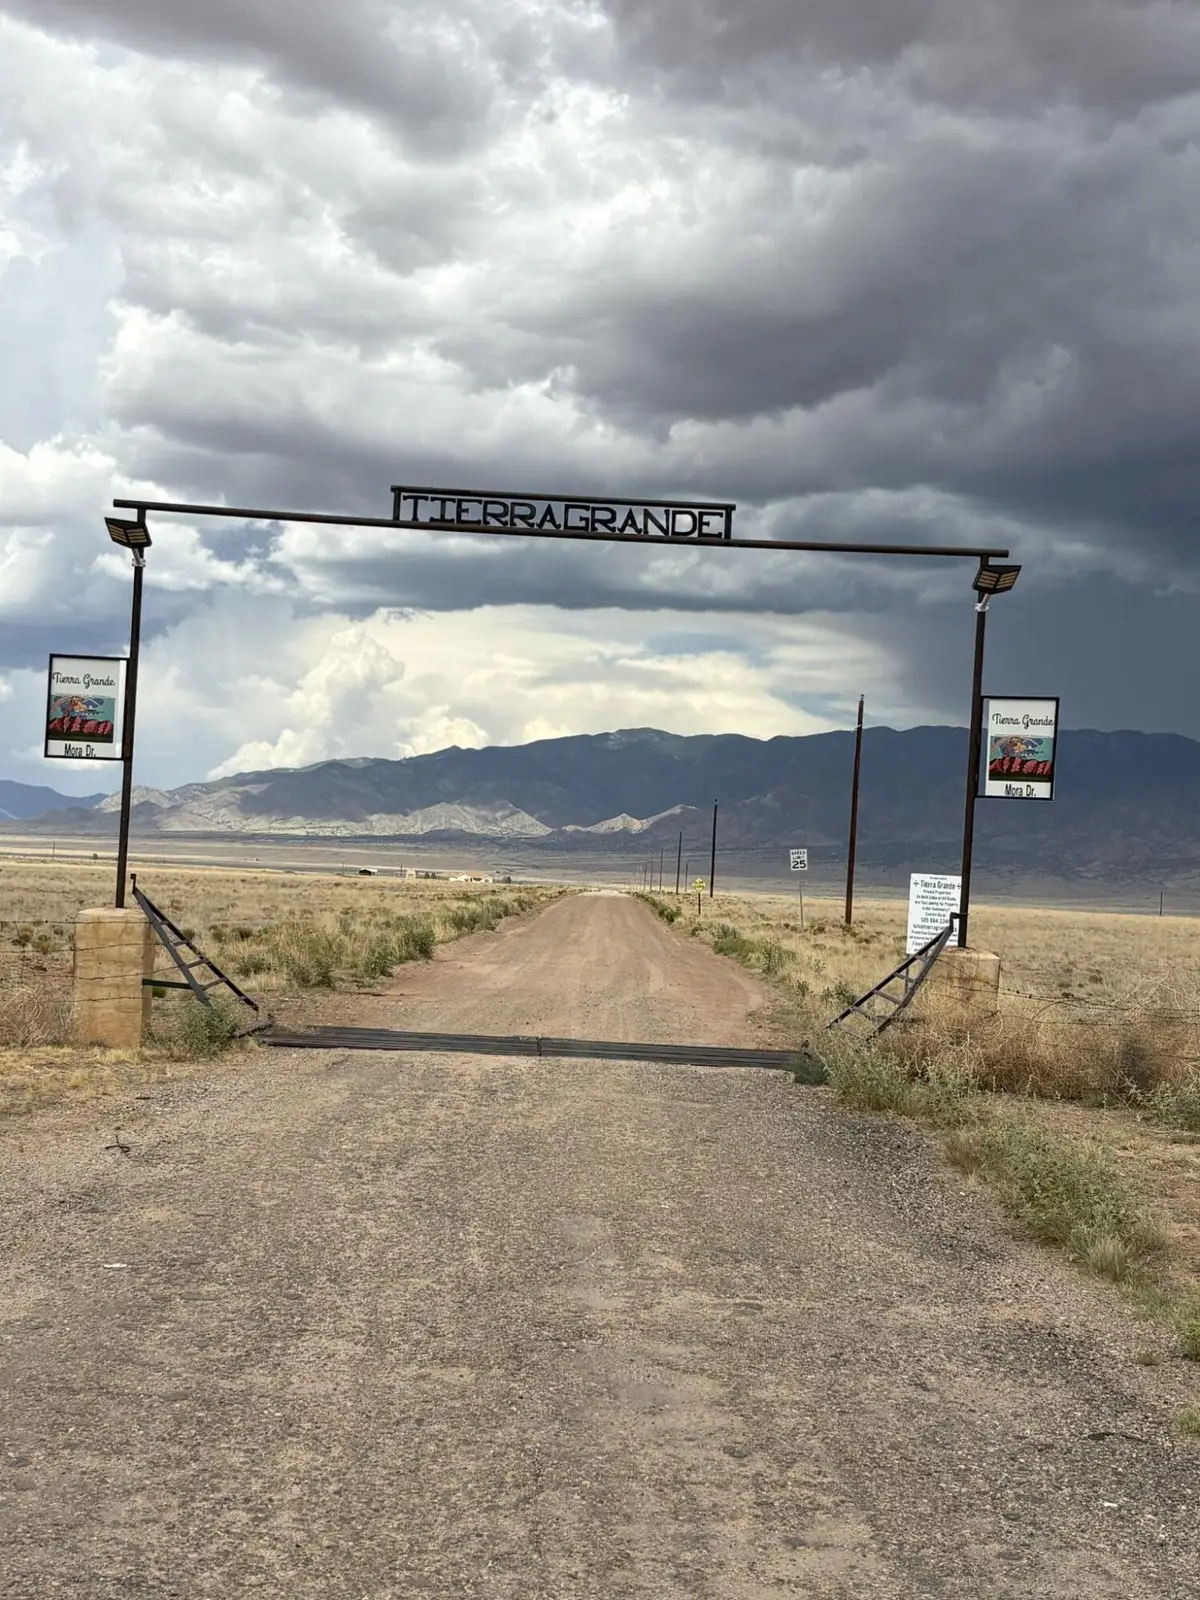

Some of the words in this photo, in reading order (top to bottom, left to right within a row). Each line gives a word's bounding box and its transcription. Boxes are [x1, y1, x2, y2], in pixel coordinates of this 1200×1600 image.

[402, 494, 561, 531] TIERRA
[564, 504, 724, 539] GRANDE
[52, 672, 81, 684] Tierra
[83, 674, 115, 689] Grande
[992, 713, 1020, 725] Tierra
[1022, 714, 1055, 729] Grande
[64, 743, 82, 757] Mora
[86, 744, 96, 757] Dr.
[1004, 783, 1023, 796] Mora
[1026, 784, 1036, 797] Dr.
[792, 860, 806, 869] 25
[920, 879, 936, 888] Tierra
[937, 881, 956, 890] Grande
